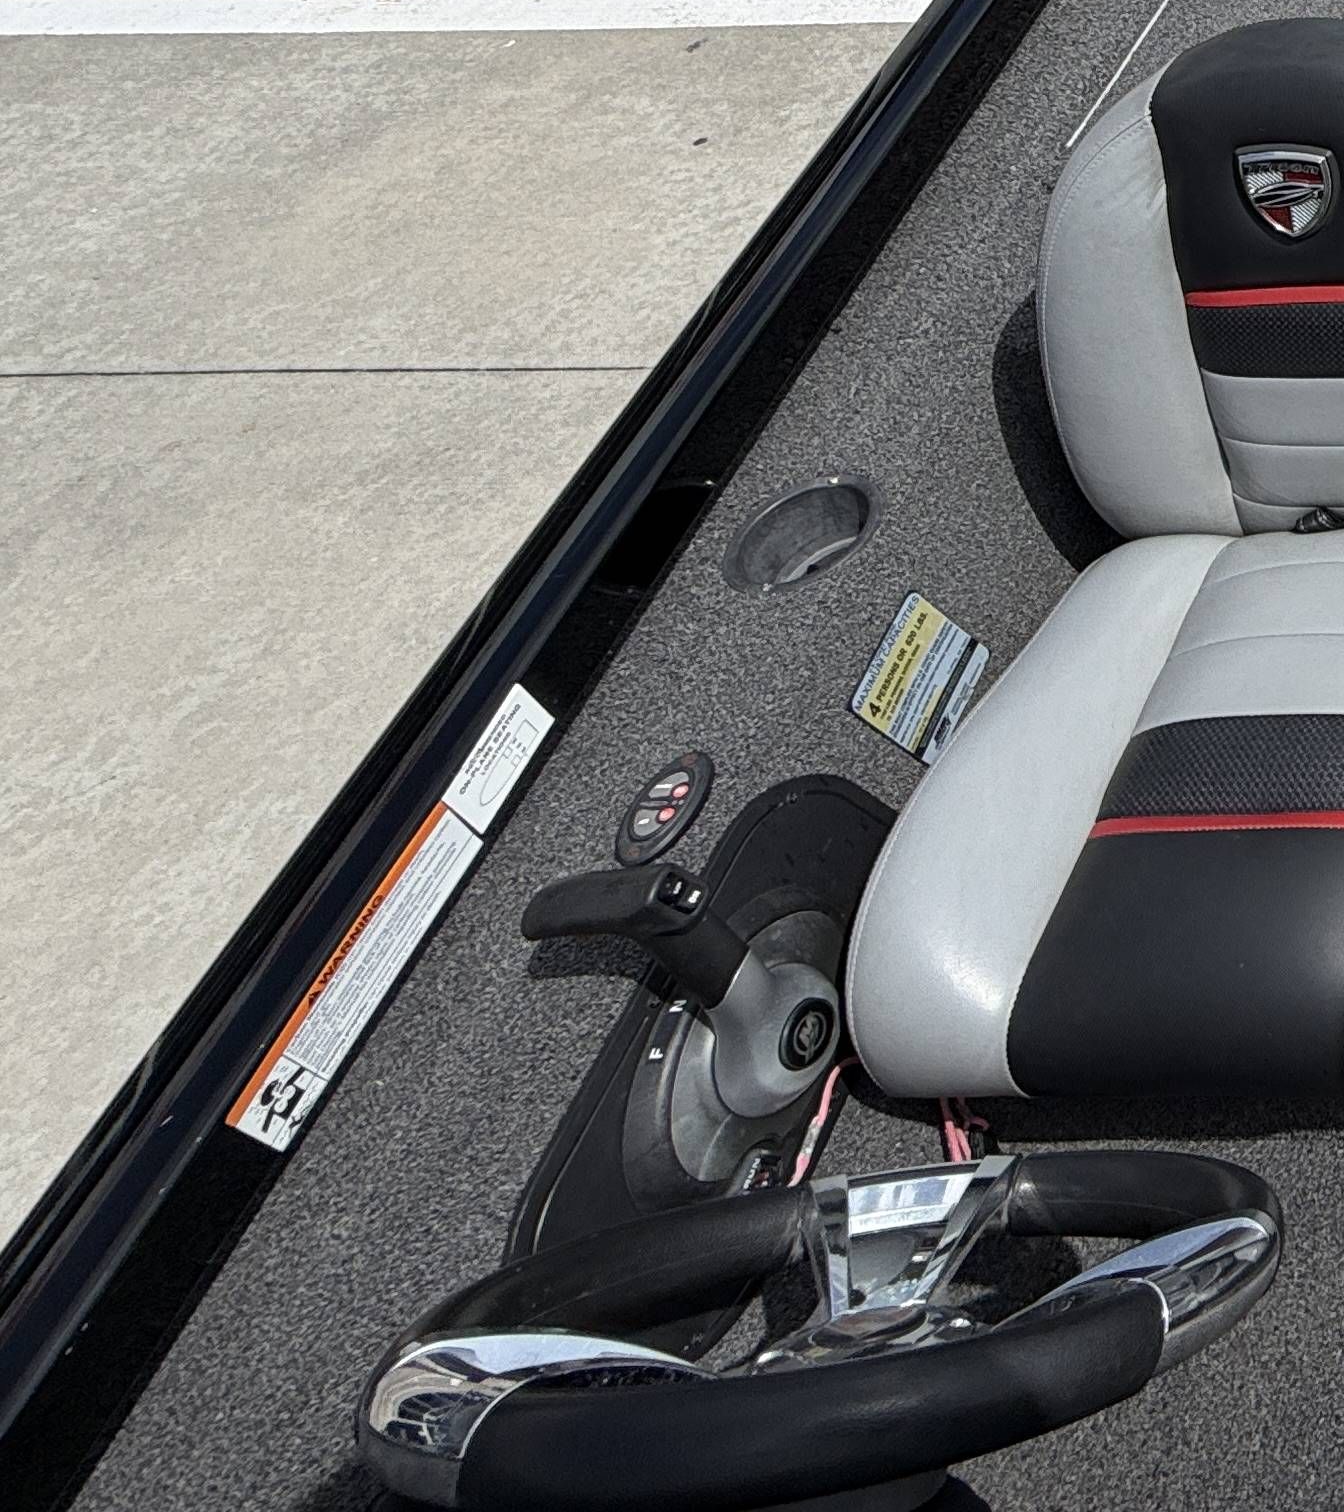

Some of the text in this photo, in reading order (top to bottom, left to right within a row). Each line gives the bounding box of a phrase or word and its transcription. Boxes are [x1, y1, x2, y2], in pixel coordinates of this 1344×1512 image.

[854, 657, 885, 712] MAXIMUM
[881, 595, 919, 657] CAPACITIES
[865, 701, 882, 718] 4
[875, 661, 900, 702] PERSONS
[895, 647, 907, 661] OR
[492, 702, 521, 744] SEATING
[317, 892, 384, 987] WARNING
[669, 1000, 687, 1012] N
[648, 1048, 663, 1060] F
